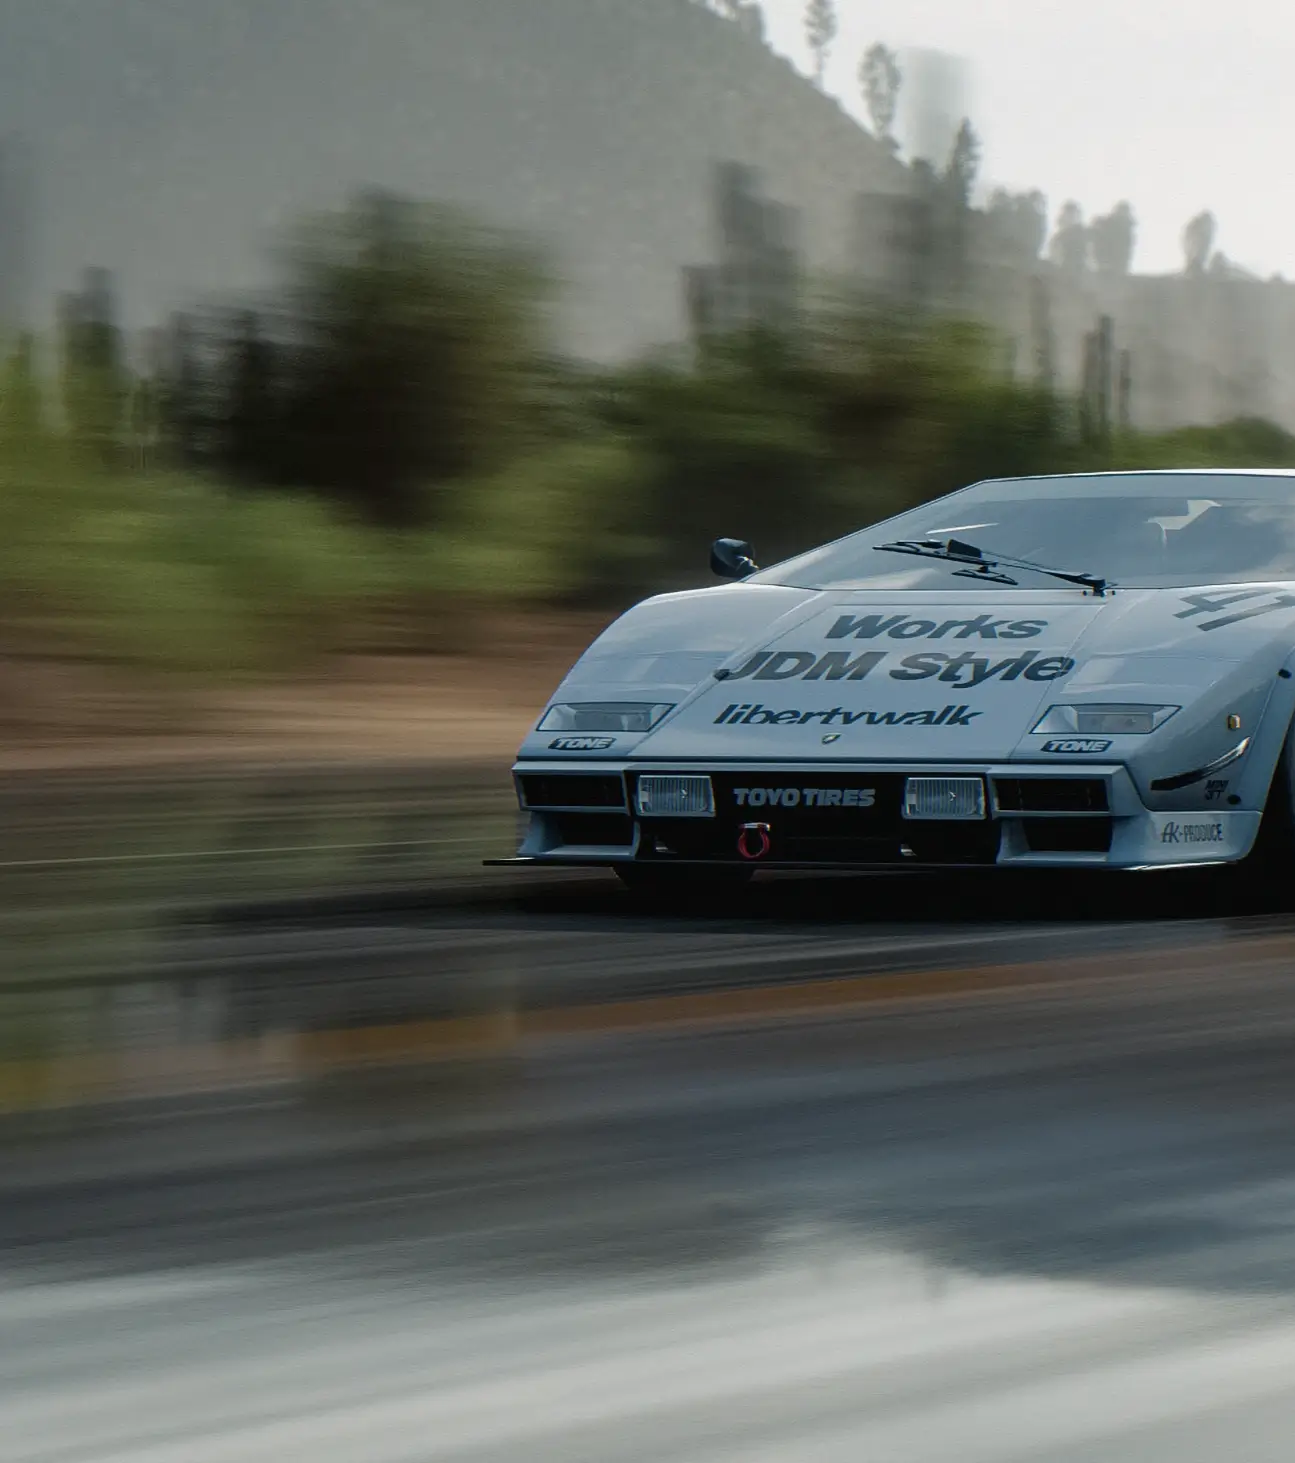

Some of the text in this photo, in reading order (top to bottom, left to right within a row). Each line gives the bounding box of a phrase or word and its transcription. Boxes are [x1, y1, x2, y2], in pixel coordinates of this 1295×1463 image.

[825, 615, 1048, 639] Works
[714, 651, 1075, 689] JDM Style
[556, 737, 614, 750] TONE
[1049, 740, 1108, 751] TONE
[733, 788, 876, 807] TOYO TIRES
